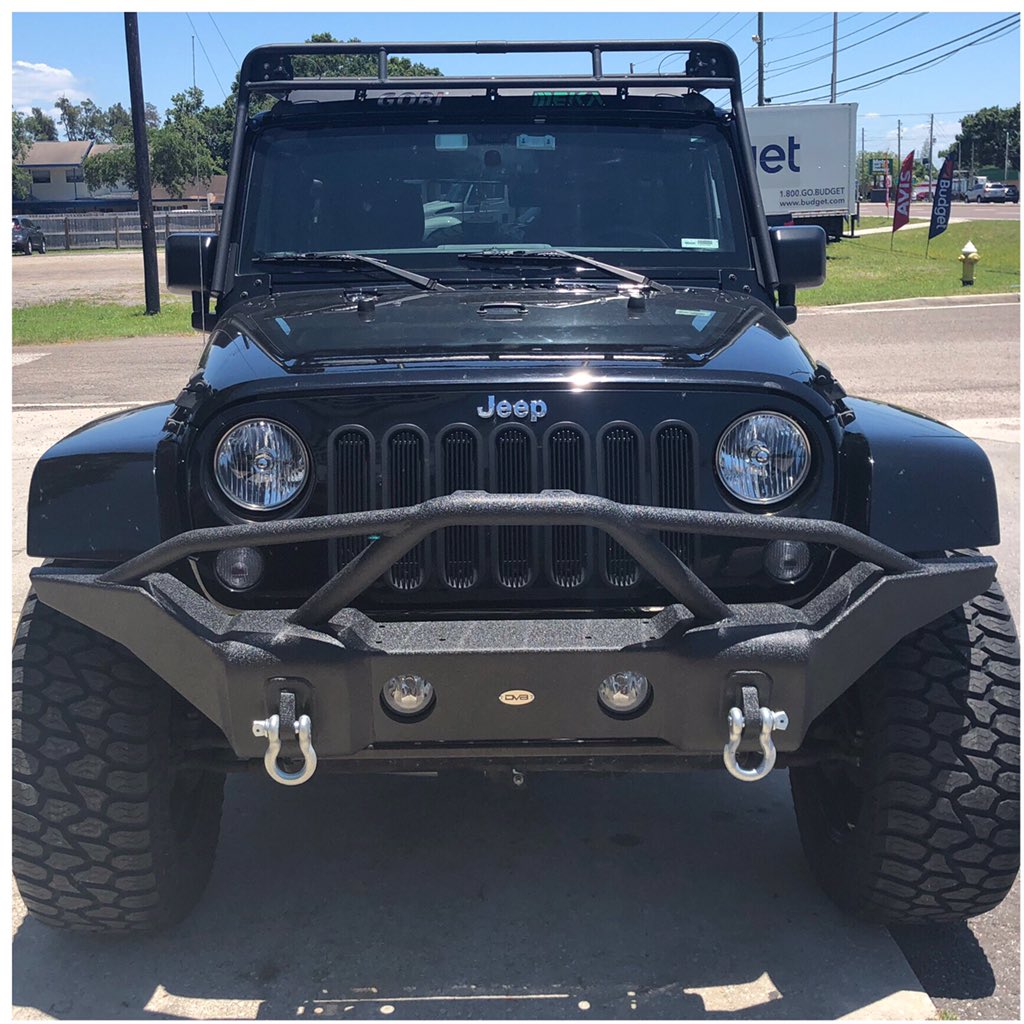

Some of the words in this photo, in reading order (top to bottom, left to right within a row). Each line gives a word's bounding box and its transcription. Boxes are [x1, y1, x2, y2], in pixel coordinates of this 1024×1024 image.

[377, 91, 445, 106] GOBI
[779, 187, 846, 198] 1.800.GO.BUDGET
[779, 198, 846, 207] www.budget.com
[896, 170, 911, 217] AVIS
[934, 180, 951, 229] Budget
[477, 395, 547, 422] Jeep
